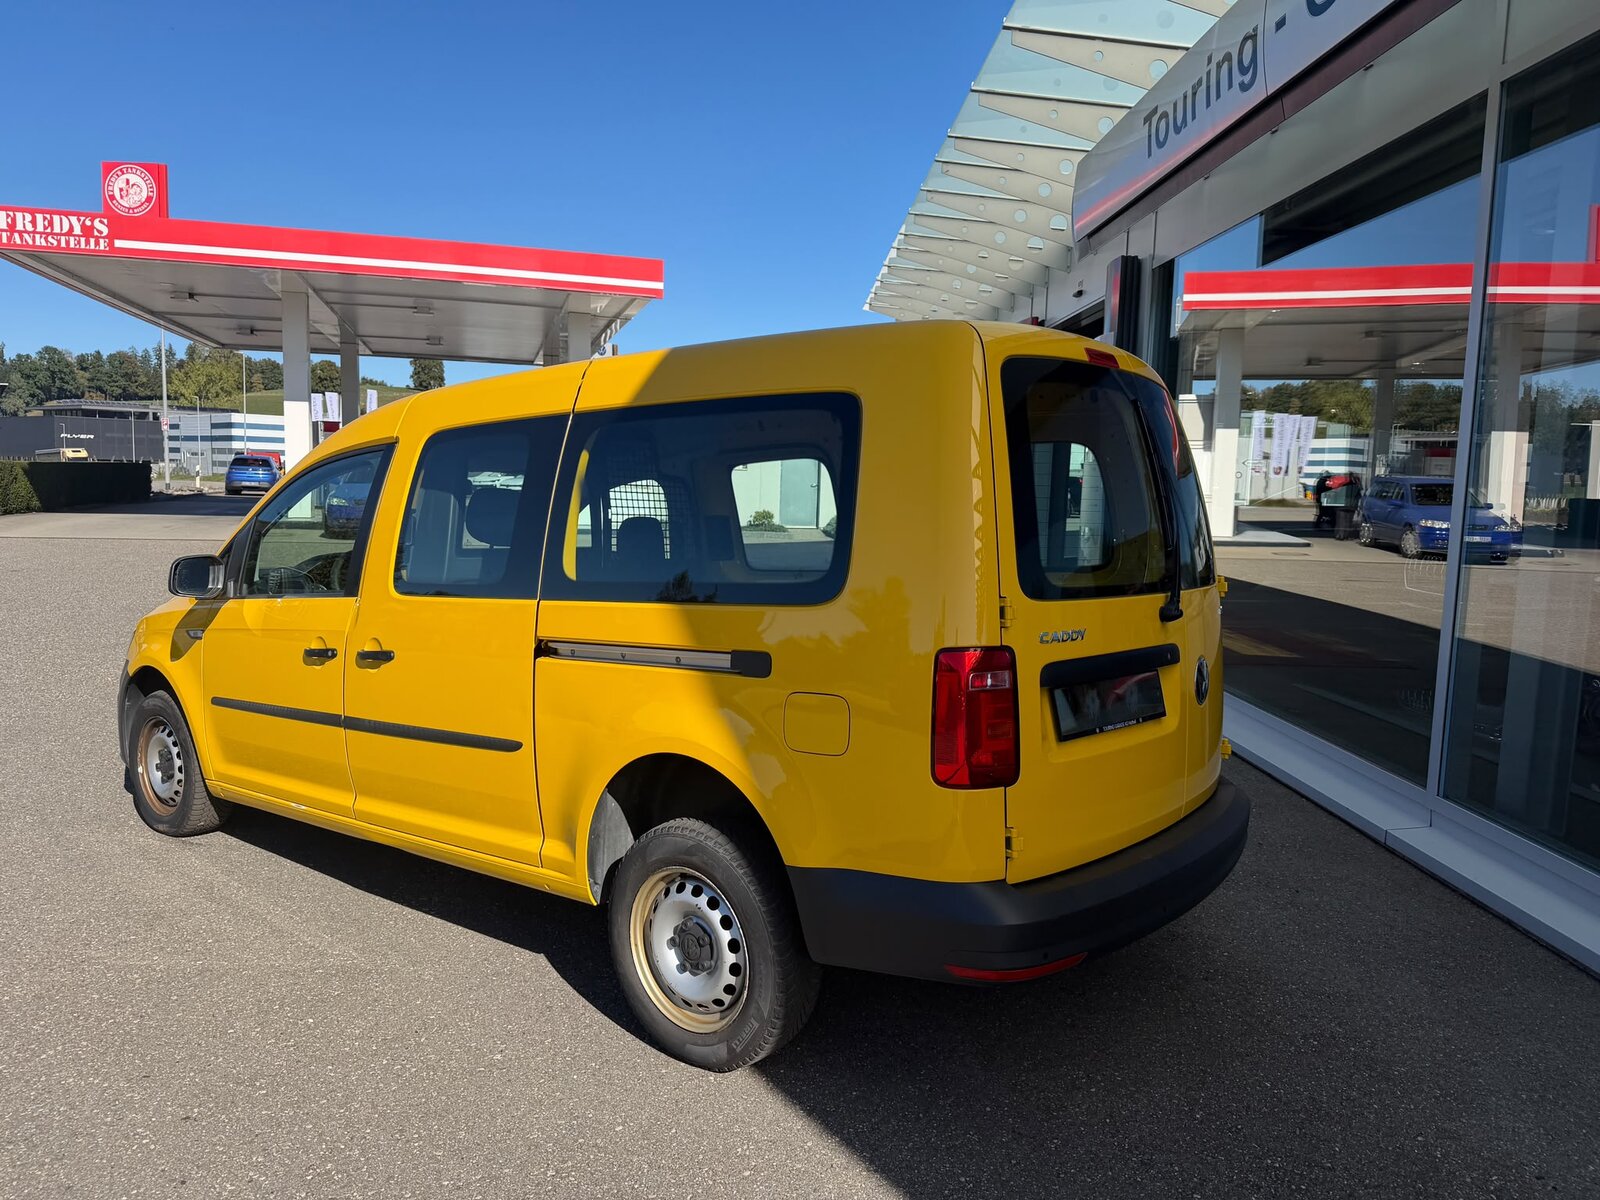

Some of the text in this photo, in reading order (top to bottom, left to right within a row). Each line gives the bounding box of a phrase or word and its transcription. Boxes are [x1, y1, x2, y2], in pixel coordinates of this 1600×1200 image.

[1143, 23, 1259, 159] Touring
[0, 211, 109, 237] FREDY'S
[0, 231, 109, 250] TANKSTELLE
[1039, 628, 1087, 644] CADDY
